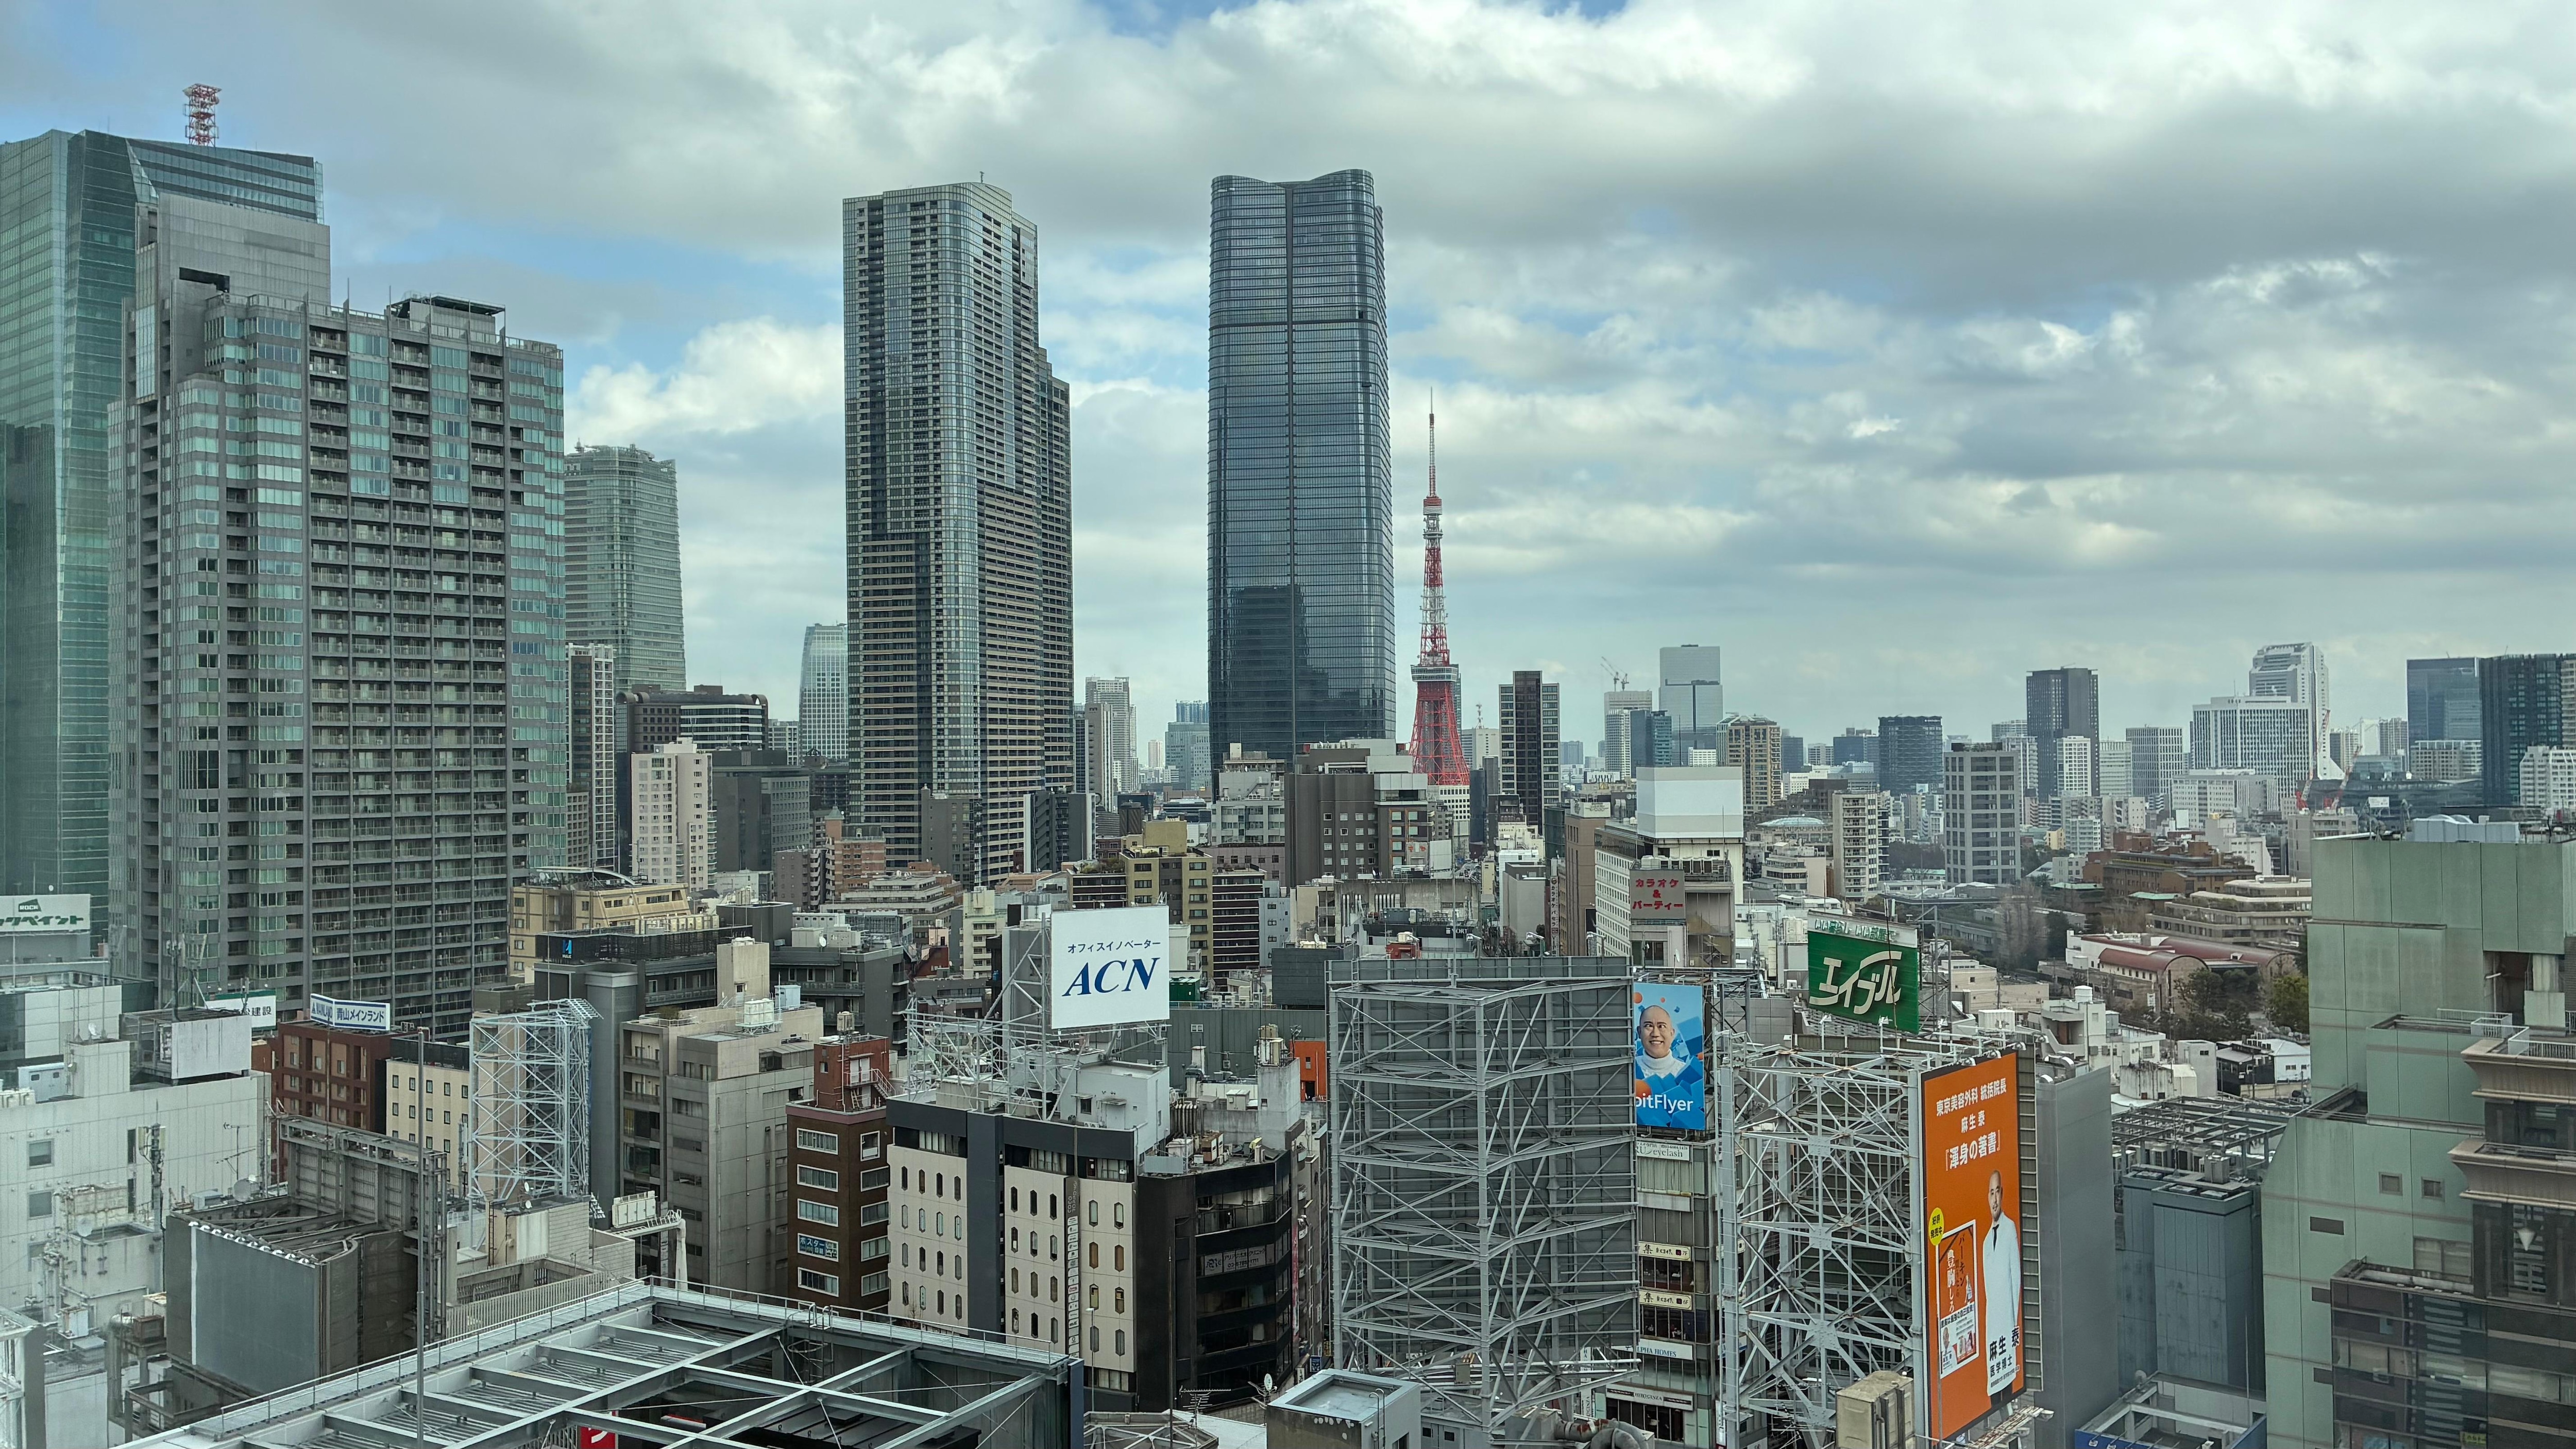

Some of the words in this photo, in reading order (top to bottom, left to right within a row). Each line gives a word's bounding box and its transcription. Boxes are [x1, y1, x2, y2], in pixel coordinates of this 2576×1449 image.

[1636, 879, 1679, 888] カラオケ
[1653, 889, 1661, 898] &
[1632, 900, 1683, 910] パーティー
[1067, 940, 1161, 953] オフィスイノベーター
[1061, 957, 1161, 997] ACN
[1809, 950, 1903, 1014] エイブル
[336, 1008, 384, 1023] 青山メインランド
[1936, 1086, 1978, 1117] 東京美容外科
[1980, 1078, 2007, 1101] 統括院長
[1961, 1113, 1976, 1133] 麻生
[1945, 1129, 2001, 1171] 『渾身の著書』
[1654, 1349, 1676, 1357] HOMES
[1989, 1335, 2006, 1361] 麻生
[2011, 1327, 2020, 1348] 泰
[1990, 1354, 2012, 1378] 医学博士
